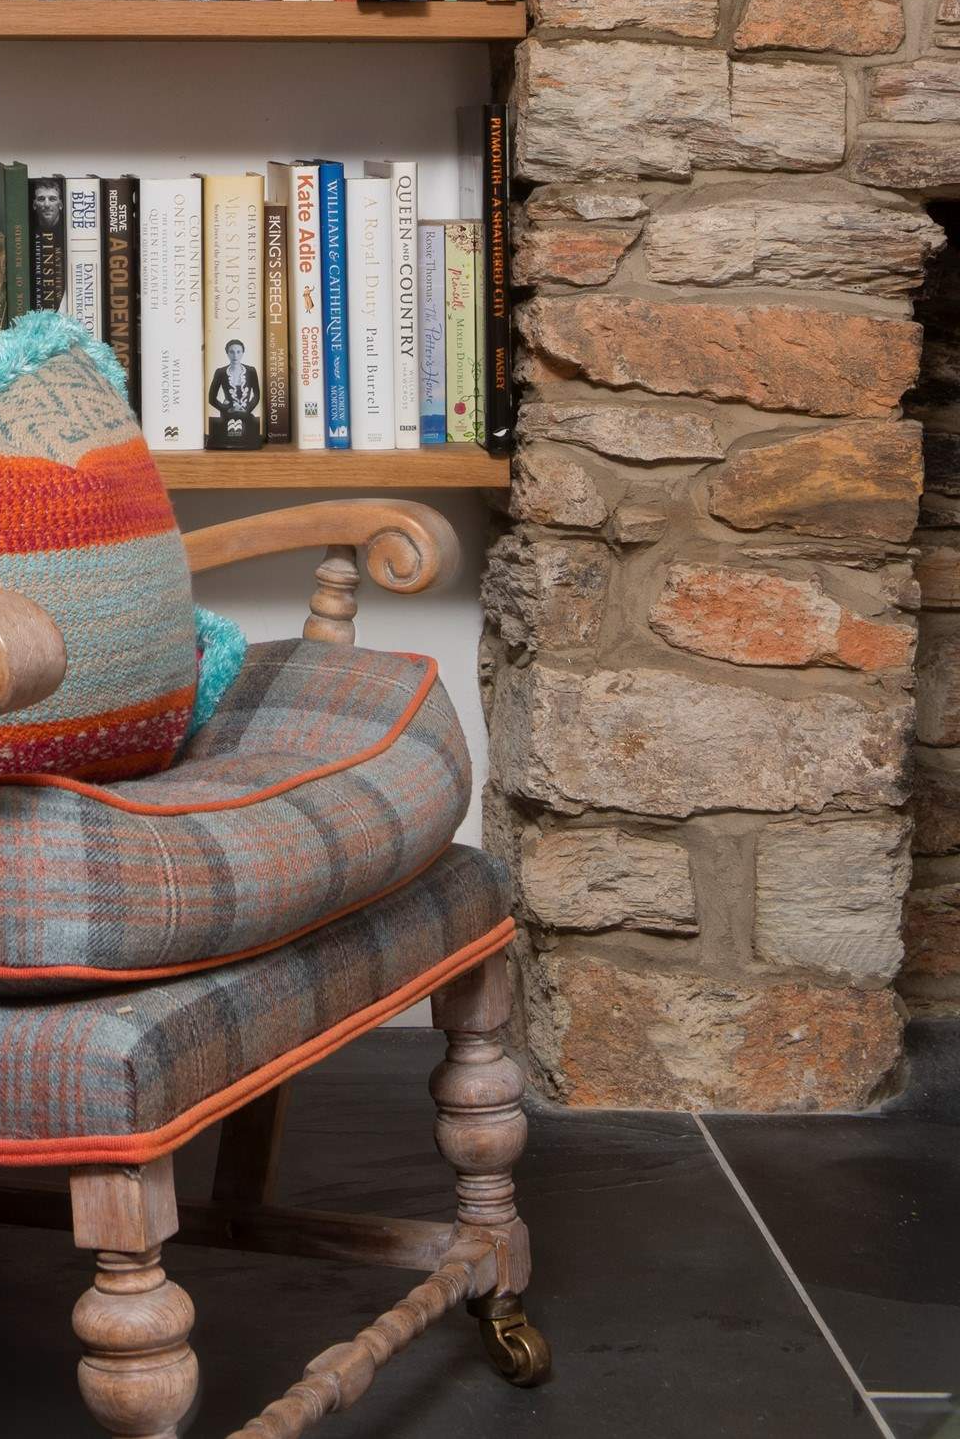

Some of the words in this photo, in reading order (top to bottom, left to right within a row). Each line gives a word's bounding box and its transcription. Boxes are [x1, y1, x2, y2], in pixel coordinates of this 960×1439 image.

[490, 117, 503, 184] PLYMOUTH
[71, 191, 84, 229] BLUE
[84, 191, 96, 229] TRUE
[109, 189, 118, 233] REDGRAVE
[119, 203, 127, 231] STEVE
[173, 193, 185, 238] ONE'S
[297, 175, 314, 222] Kate
[327, 179, 339, 248] WILLIAM
[364, 196, 378, 208] A
[396, 175, 413, 240] QUEEN
[492, 197, 502, 208] A
[149, 208, 159, 246] QUEEN
[247, 204, 257, 262] CHARLES
[360, 218, 380, 265] Royal
[425, 231, 436, 259] Rosie
[492, 211, 504, 285] SHATTERED
[189, 214, 200, 303] COUNTING
[298, 228, 315, 274] Adie
[328, 250, 339, 263] &
[84, 263, 94, 311] DANIEL
[150, 251, 159, 311] ELIZABETH
[174, 245, 186, 324] BLESSINGS
[247, 267, 257, 320] HIGHAM
[361, 274, 380, 317] Duty
[425, 259, 437, 303] Thomas
[494, 288, 505, 319] CITY
[327, 264, 342, 353] CATHERINE
[400, 263, 413, 358] COUNTRY
[301, 326, 311, 386] Camouflage
[311, 326, 320, 366] Corsets
[366, 327, 379, 357] Paul
[456, 318, 465, 349] MIXED
[160, 349, 169, 414] SHAWCROSS
[172, 358, 180, 405] WILLIAM
[312, 368, 320, 379] to
[366, 365, 380, 415] Burrell
[456, 352, 465, 395] DOUBLES
[495, 346, 505, 391] WASLEY
[330, 385, 339, 421] MORTON
